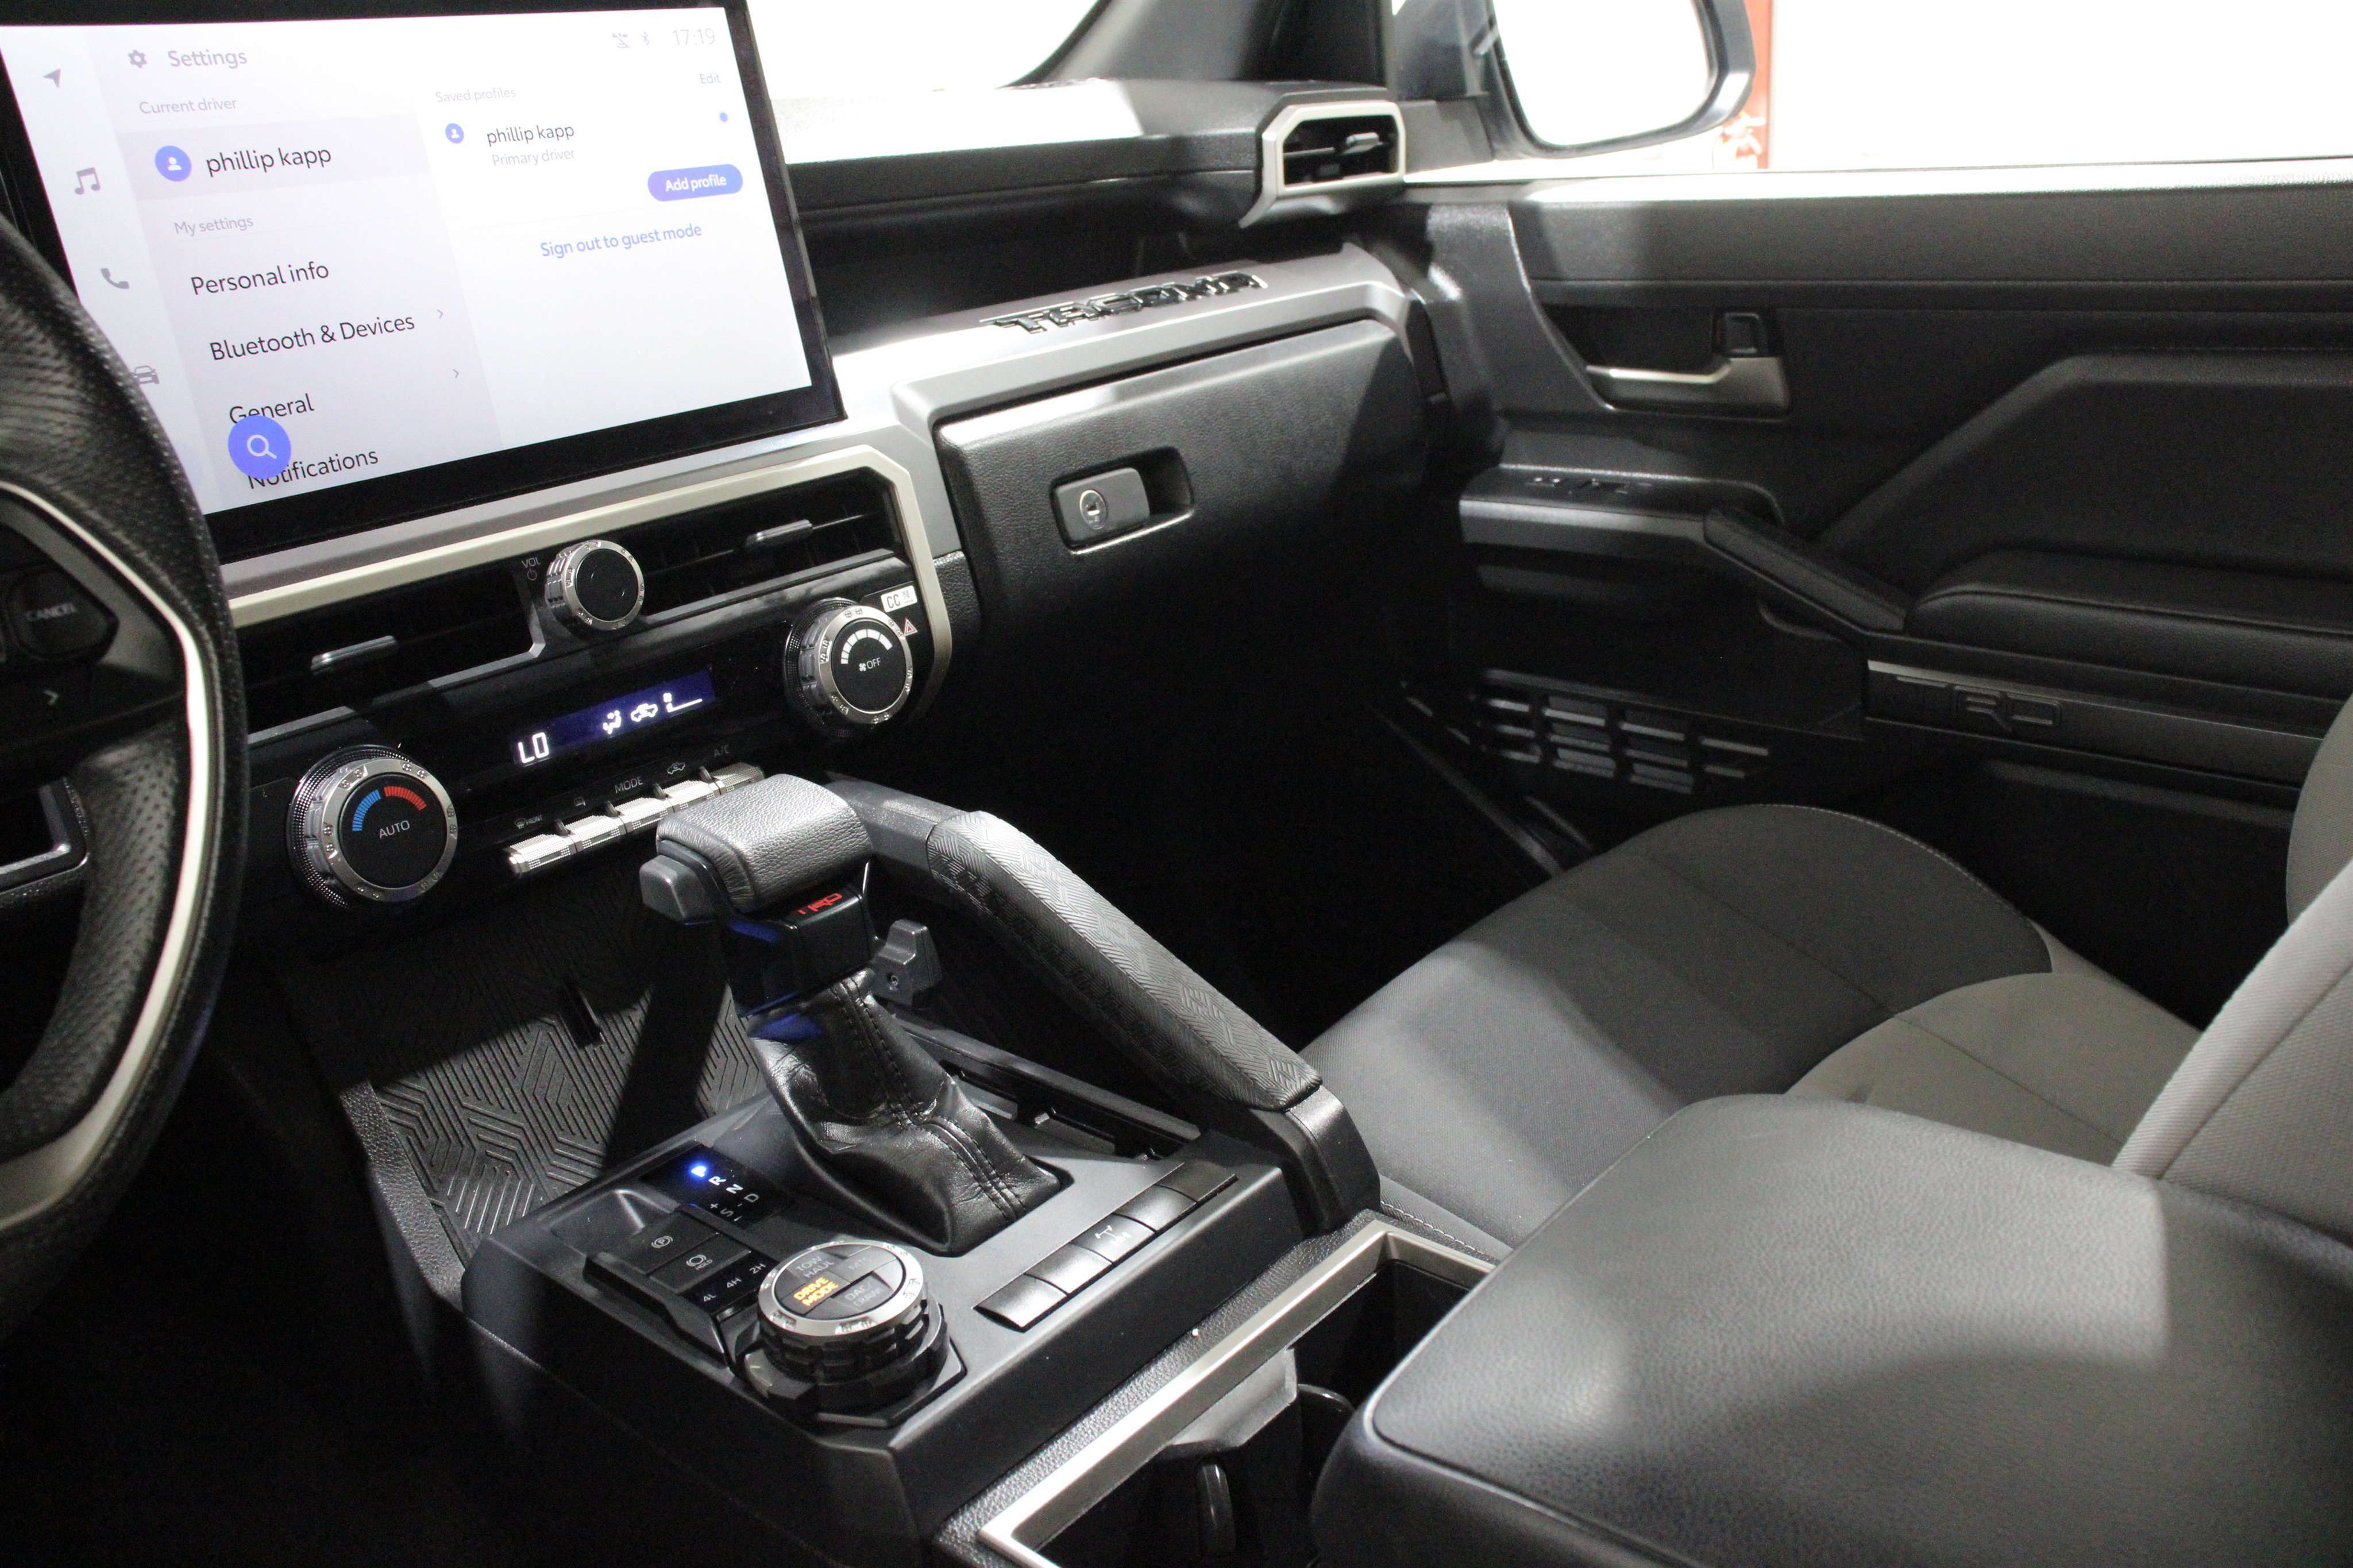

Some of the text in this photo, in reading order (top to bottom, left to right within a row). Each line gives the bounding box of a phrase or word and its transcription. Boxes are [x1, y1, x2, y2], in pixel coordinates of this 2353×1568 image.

[672, 28, 716, 47] 17:19
[168, 48, 248, 69] Settings
[699, 72, 722, 84] Edit
[435, 87, 516, 103] Saved profiles
[139, 98, 237, 115] Current driver
[486, 123, 574, 146] phillip kapp
[206, 146, 331, 177] phillip kapp
[492, 148, 575, 167] Primary driver
[665, 175, 727, 192] Add profile
[174, 215, 254, 237] My settings
[540, 223, 702, 258] Sign out to guest mode
[191, 261, 330, 295] Personal info
[210, 314, 415, 361] Bluetooth & Devices
[520, 557, 541, 569] VOL
[866, 656, 881, 669] OFF
[518, 732, 550, 764] LO
[713, 744, 730, 758] A/C
[615, 776, 643, 794] MODE
[526, 814, 543, 826] FRONT
[379, 820, 410, 839] AUTO
[708, 1176, 727, 1186] R
[726, 1183, 743, 1194] N
[743, 1194, 759, 1203] D
[749, 1263, 766, 1274] 2H
[795, 1255, 823, 1272] TOW
[803, 1261, 835, 1279] HAUL
[726, 1277, 742, 1288] 4H
[792, 1277, 830, 1301] DRIVE
[703, 1293, 717, 1302] 4L
[801, 1281, 839, 1307] MODE
